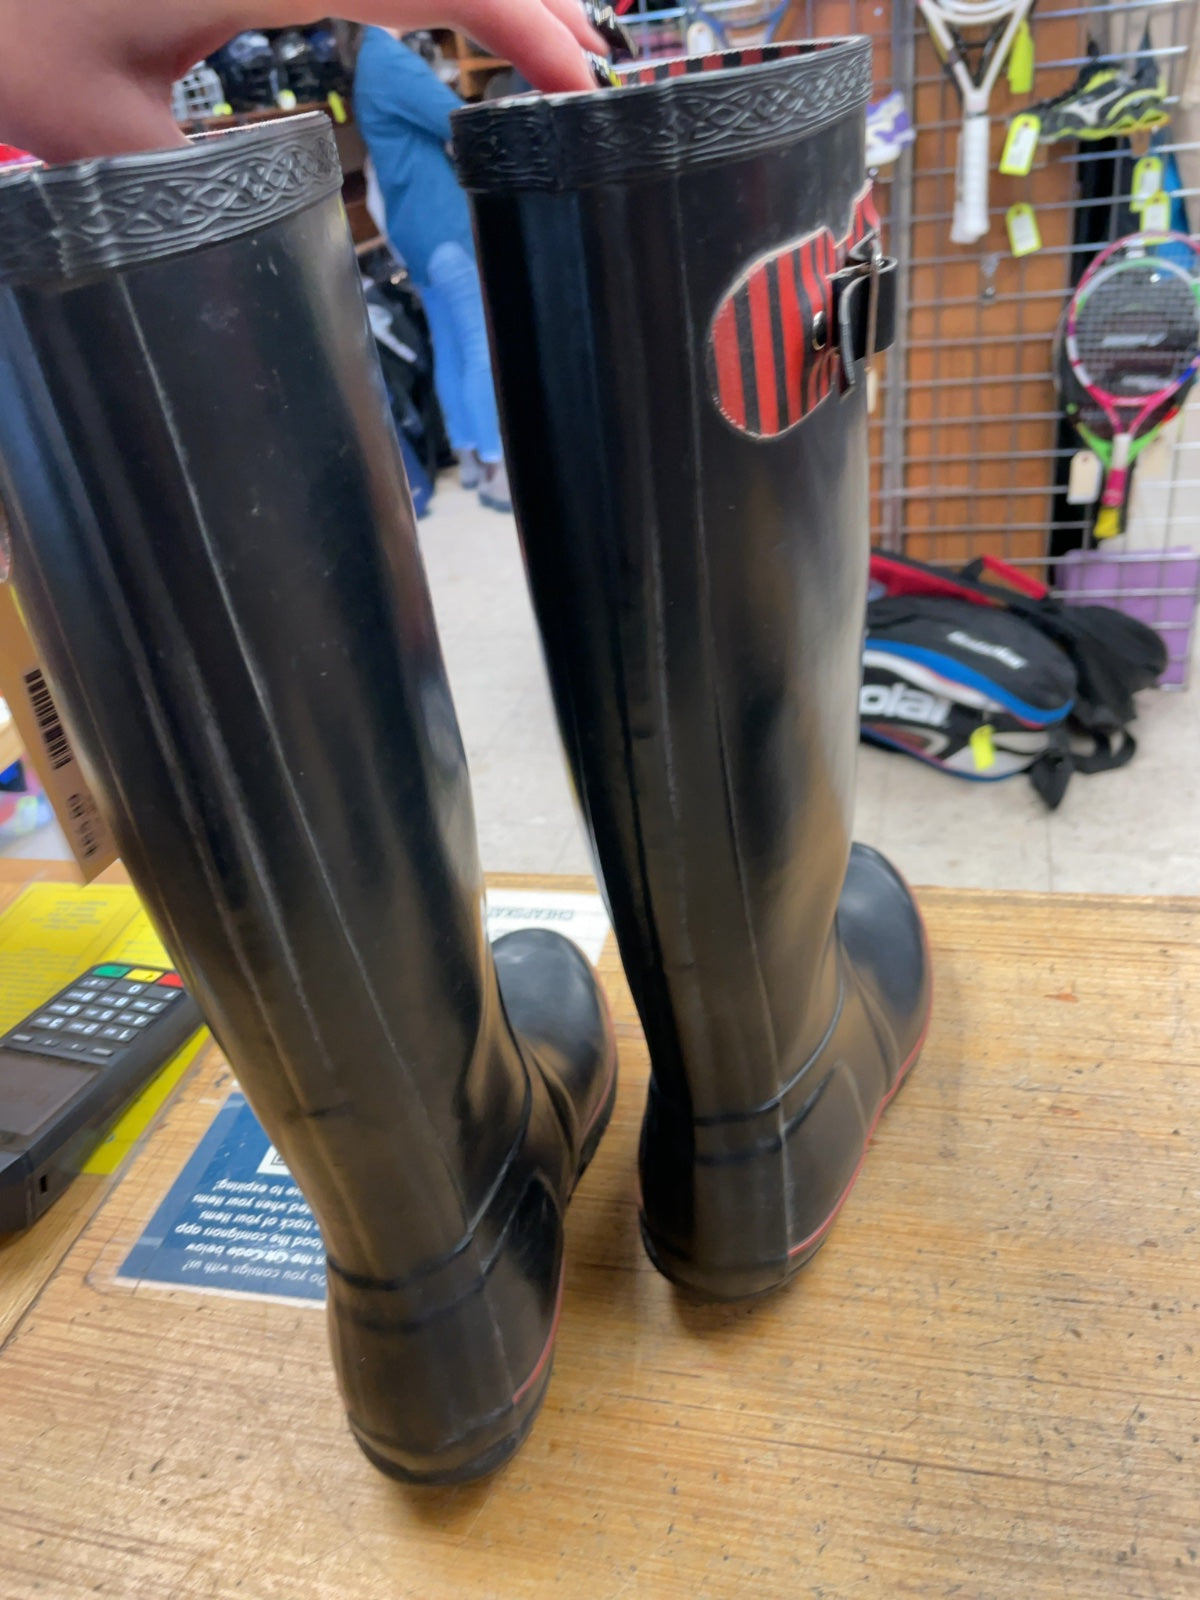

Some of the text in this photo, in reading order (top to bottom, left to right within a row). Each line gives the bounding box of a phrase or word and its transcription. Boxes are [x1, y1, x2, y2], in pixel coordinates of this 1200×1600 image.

[212, 1178, 269, 1193] expiring!
[269, 1185, 285, 1196] to
[191, 1193, 226, 1207] items
[225, 1196, 256, 1208] your
[254, 1200, 288, 1213] when
[199, 1210, 233, 1224] items
[233, 1213, 264, 1226] your
[260, 1216, 278, 1228] of
[174, 1222, 202, 1235] app
[279, 1218, 314, 1231] track
[269, 1233, 292, 1247] the
[290, 1236, 324, 1251] load
[184, 1242, 226, 1257] below
[290, 1253, 313, 1266] the
[204, 1261, 229, 1274] with
[231, 1263, 280, 1278] consign
[282, 1269, 309, 1281] you
